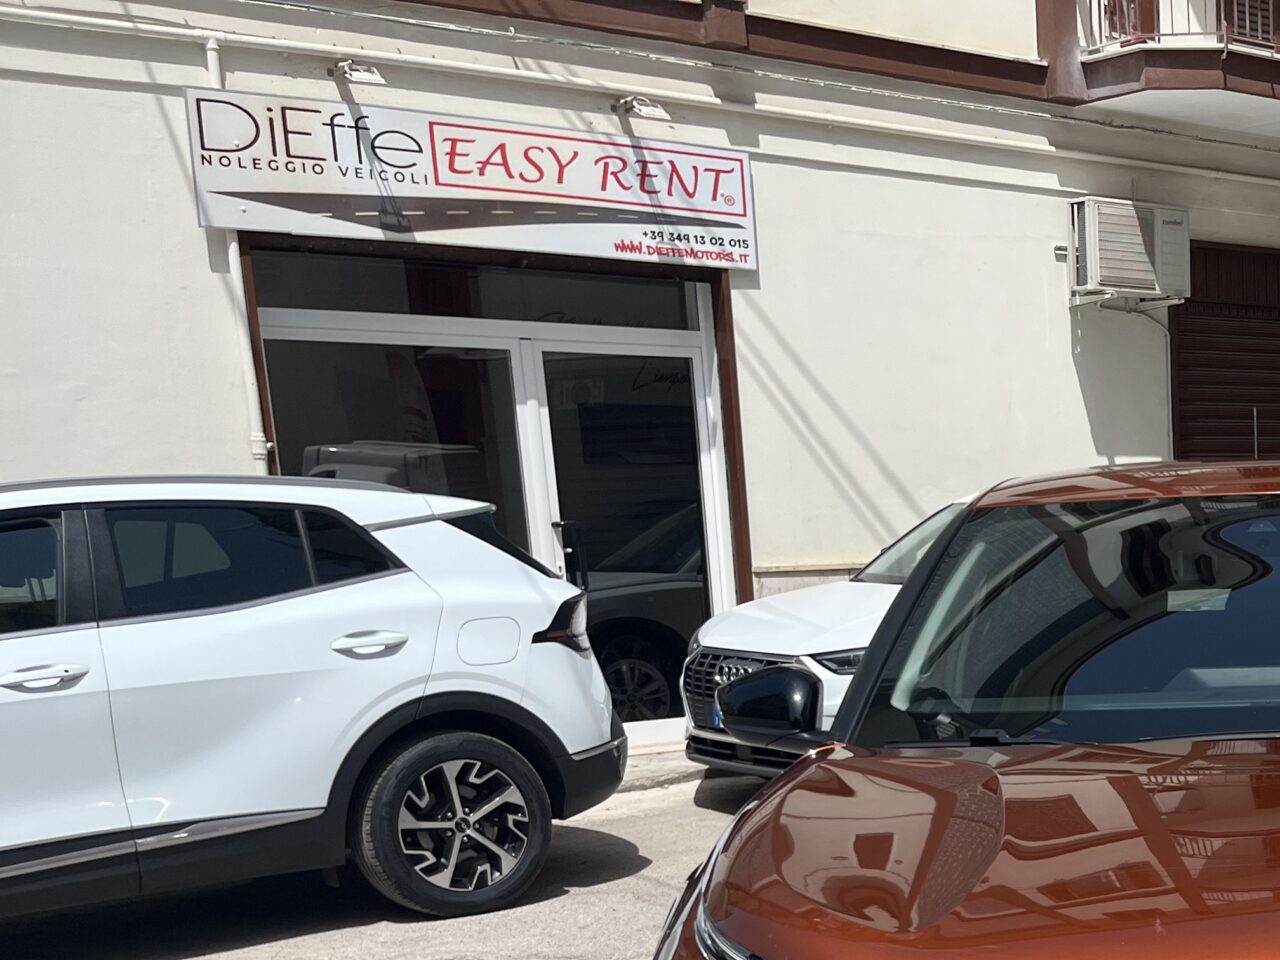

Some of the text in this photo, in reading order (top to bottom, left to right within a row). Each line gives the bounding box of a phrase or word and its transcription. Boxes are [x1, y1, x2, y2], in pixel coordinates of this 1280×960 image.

[196, 97, 424, 169] DiEffe
[200, 154, 429, 186] NOLEGGIO VEICOLI
[441, 136, 735, 202] EASY RENT
[642, 230, 749, 250] +39 349 13 02 015
